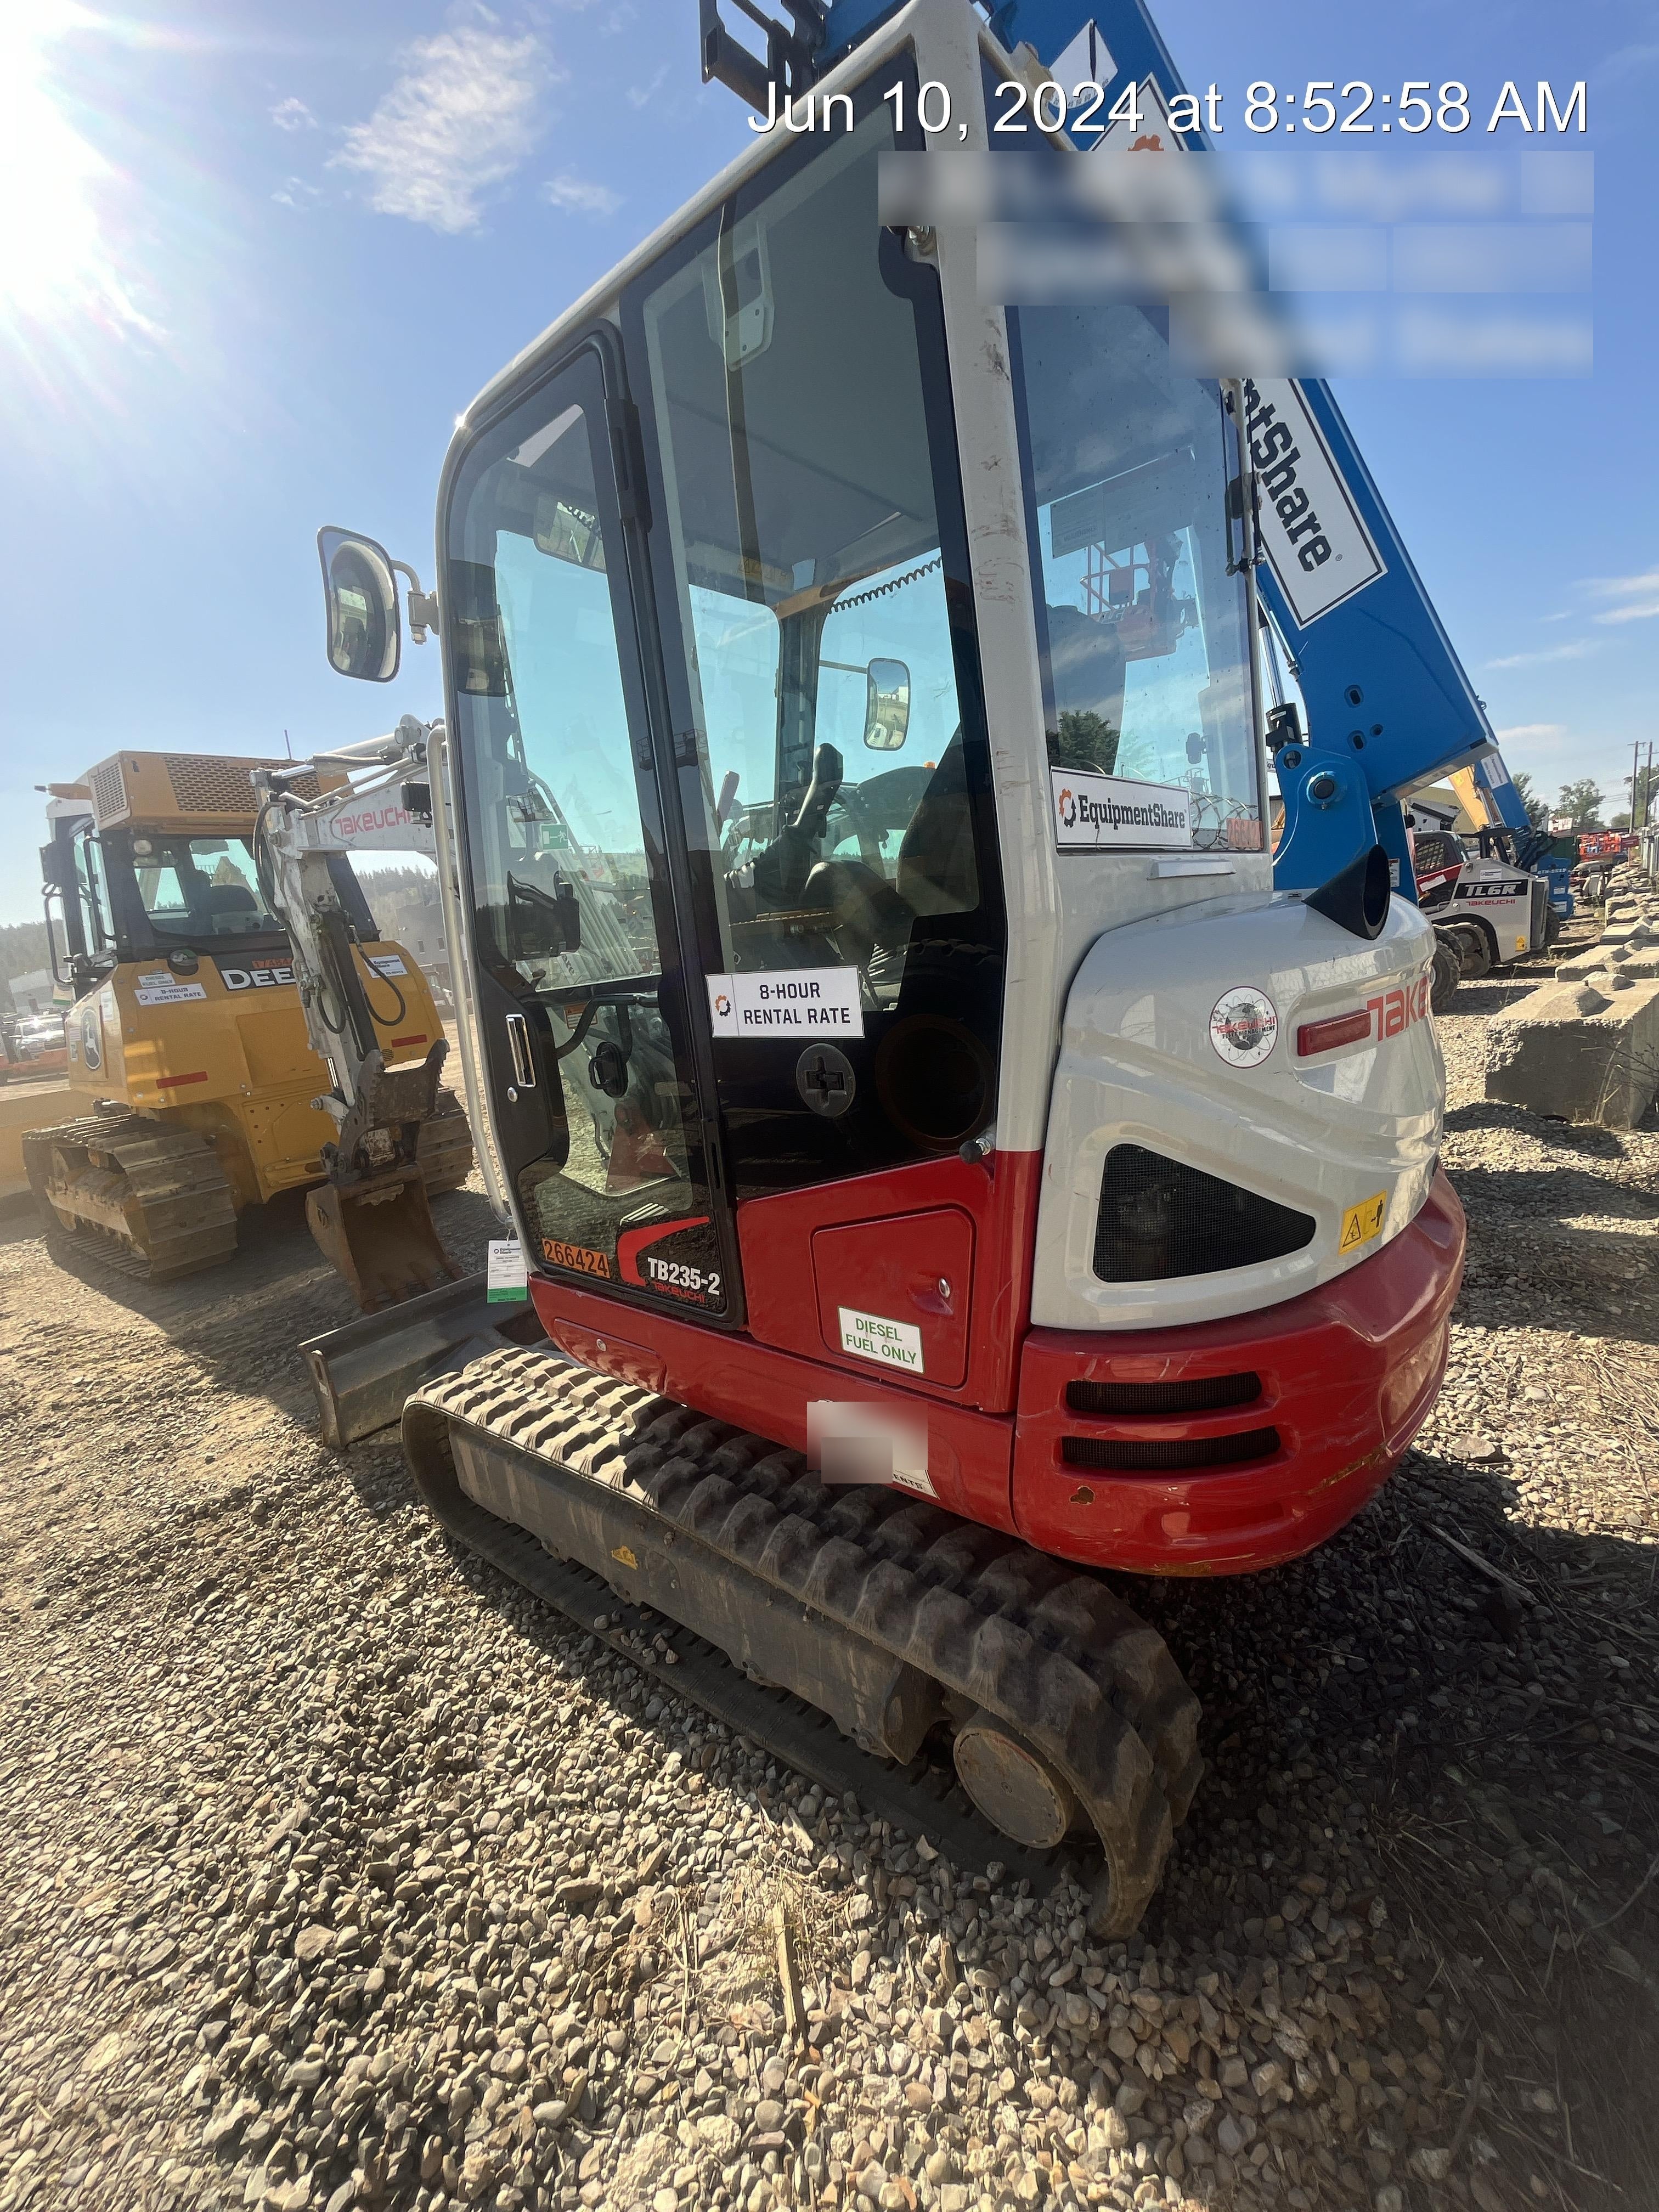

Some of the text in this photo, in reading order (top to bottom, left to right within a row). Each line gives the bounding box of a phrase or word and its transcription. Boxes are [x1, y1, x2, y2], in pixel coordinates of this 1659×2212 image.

[1078, 794, 1186, 830] EquipmentShare
[1465, 881, 1522, 896] TL6R
[759, 983, 821, 1000] 8-HOUR
[743, 1007, 851, 1024] RENTAL RATE
[544, 1239, 608, 1277] 266424
[647, 1256, 721, 1296] TB235-2
[855, 1317, 902, 1342] DIESEL
[845, 1333, 917, 1365] FUEL ONLY
